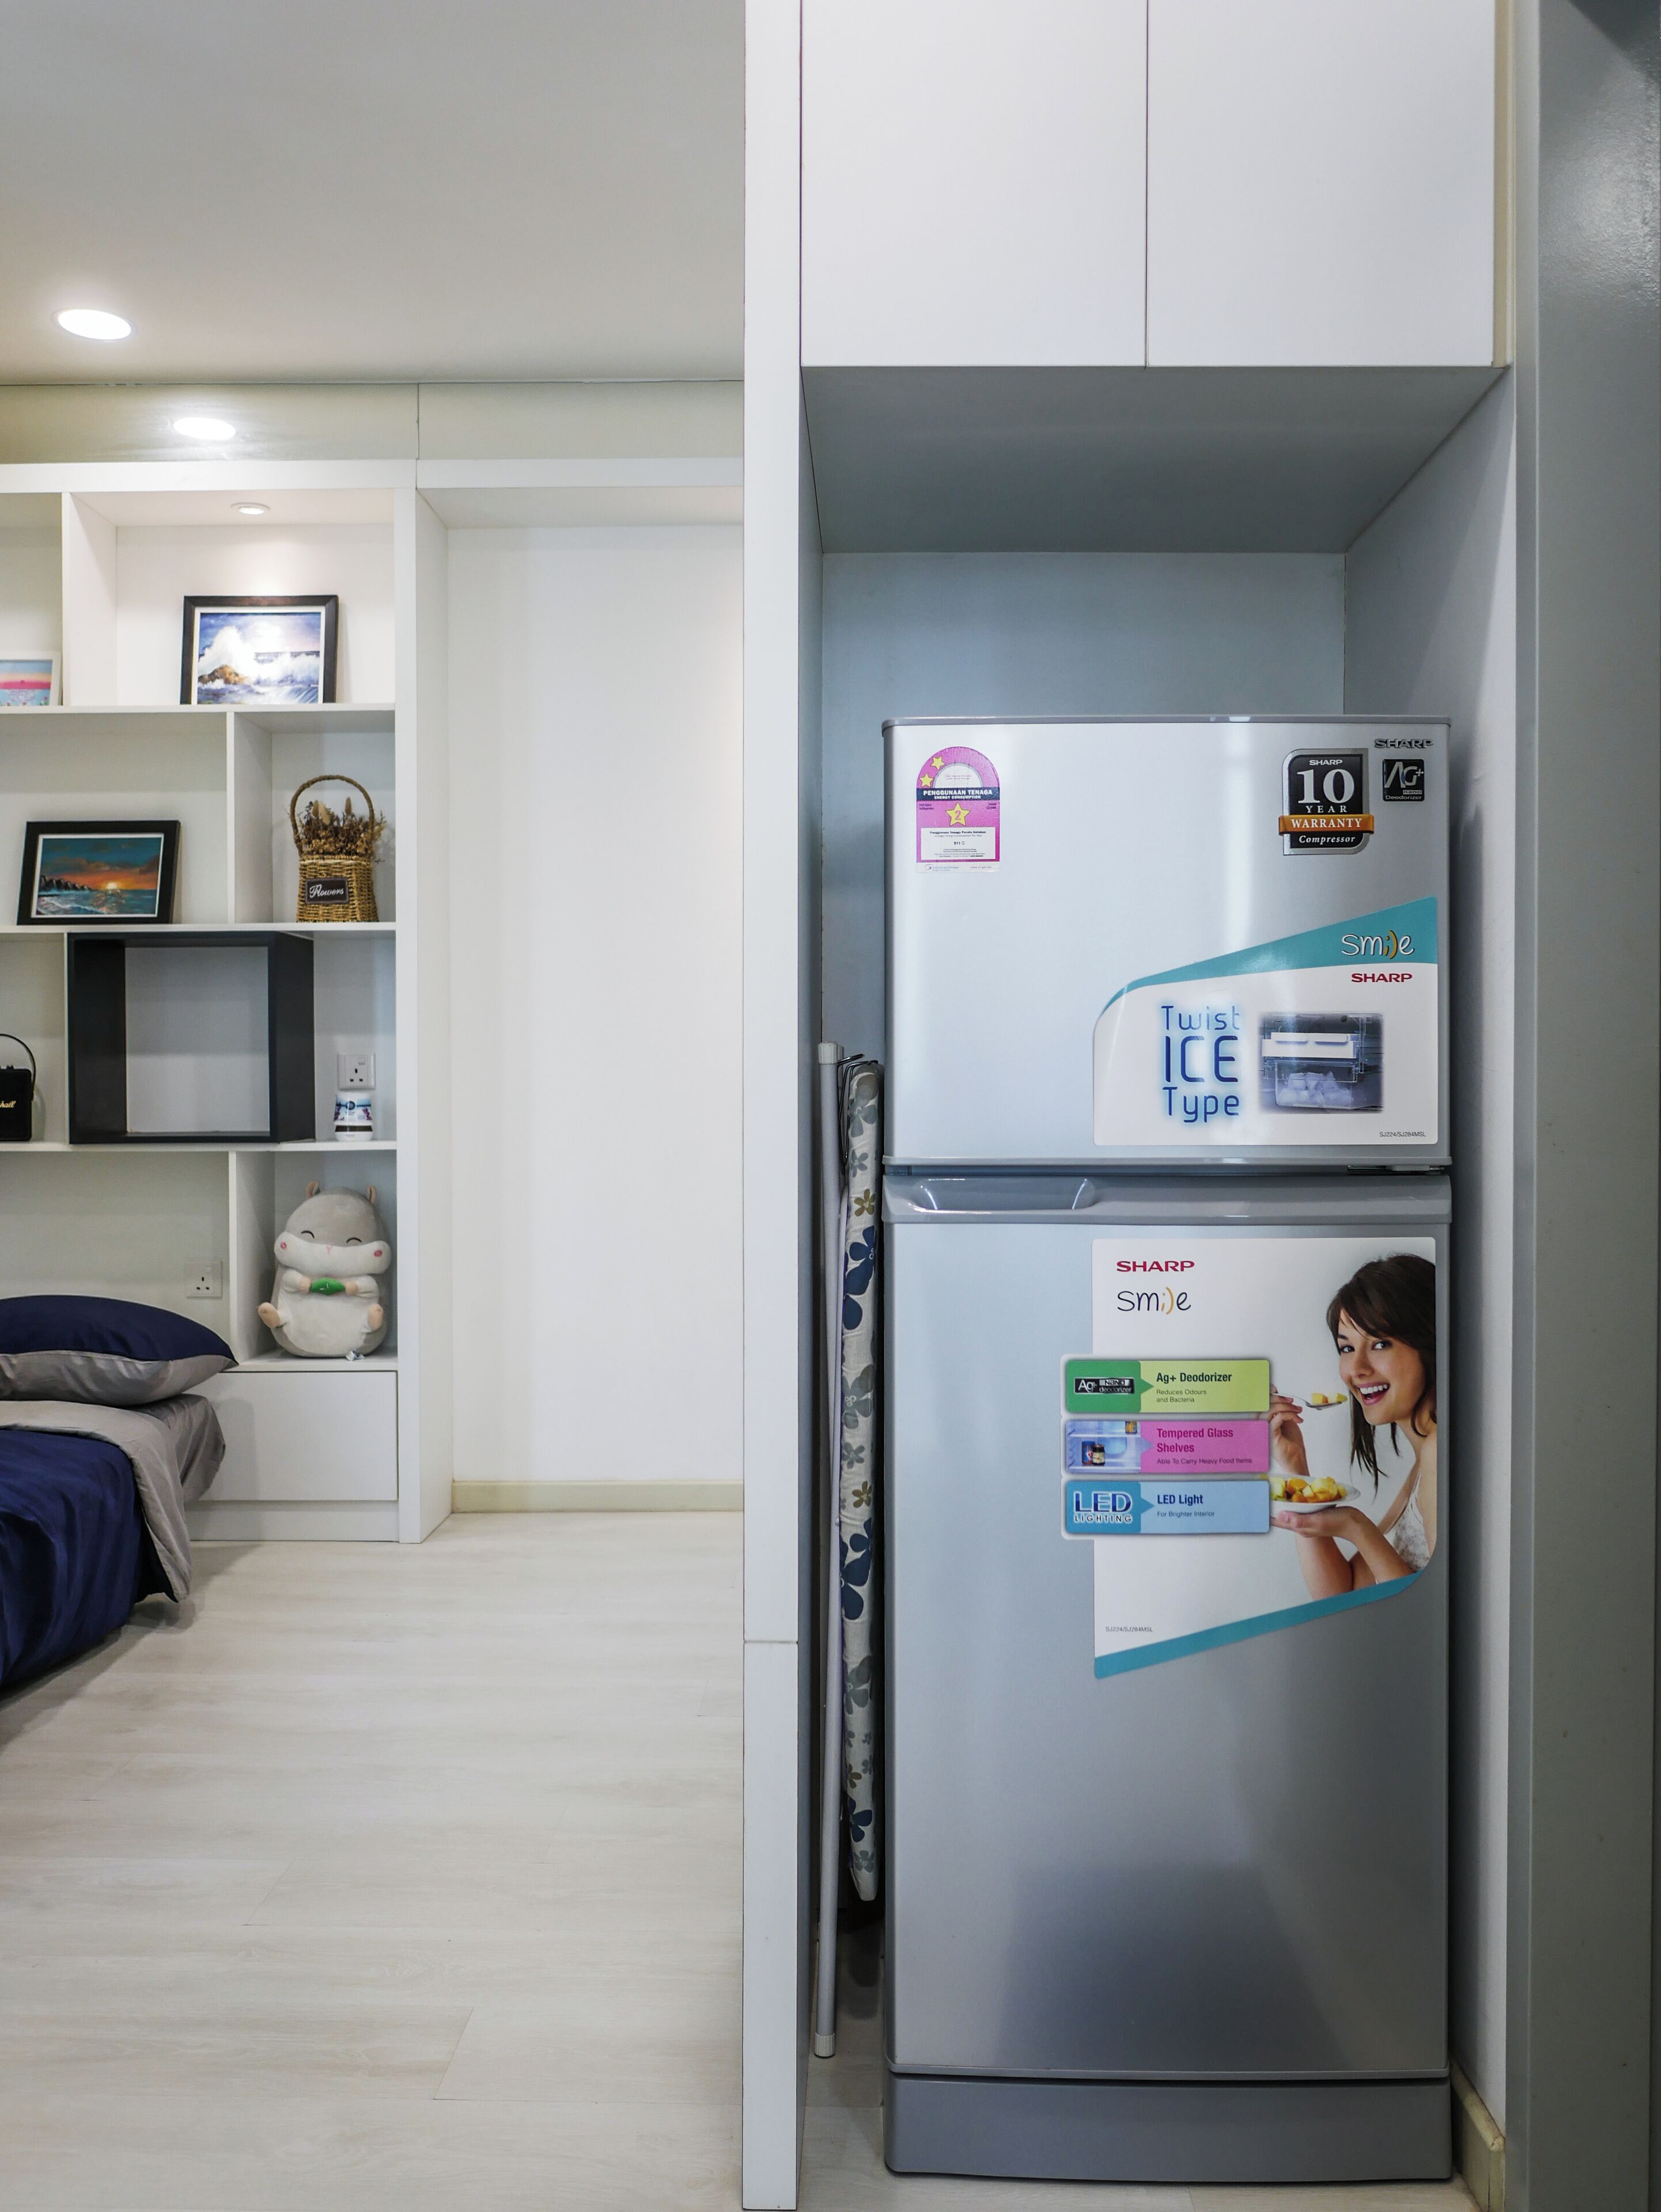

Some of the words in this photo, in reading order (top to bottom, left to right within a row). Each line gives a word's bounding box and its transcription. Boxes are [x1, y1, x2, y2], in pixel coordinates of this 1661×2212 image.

[1374, 738, 1434, 748] SHARP
[1297, 769, 1354, 804] 10
[954, 810, 961, 821] 2
[1291, 818, 1363, 828] WARRANTY
[1299, 835, 1355, 845] Compressor
[309, 884, 344, 899] Flowers
[1351, 973, 1413, 983] SHARP
[1161, 1005, 1240, 1031] Twist
[1165, 1035, 1239, 1083] ICE
[1162, 1086, 1240, 1123] Type
[1117, 1260, 1195, 1272] SHARP
[1156, 1372, 1176, 1384] Ag+
[1179, 1372, 1232, 1382] Deodorizer
[1157, 1428, 1204, 1440] Tempered
[1208, 1428, 1234, 1437] Glass
[1157, 1443, 1194, 1452] Shelves
[1074, 1493, 1132, 1513] LED
[1157, 1494, 1175, 1504] LED
[1179, 1494, 1203, 1506] Light
